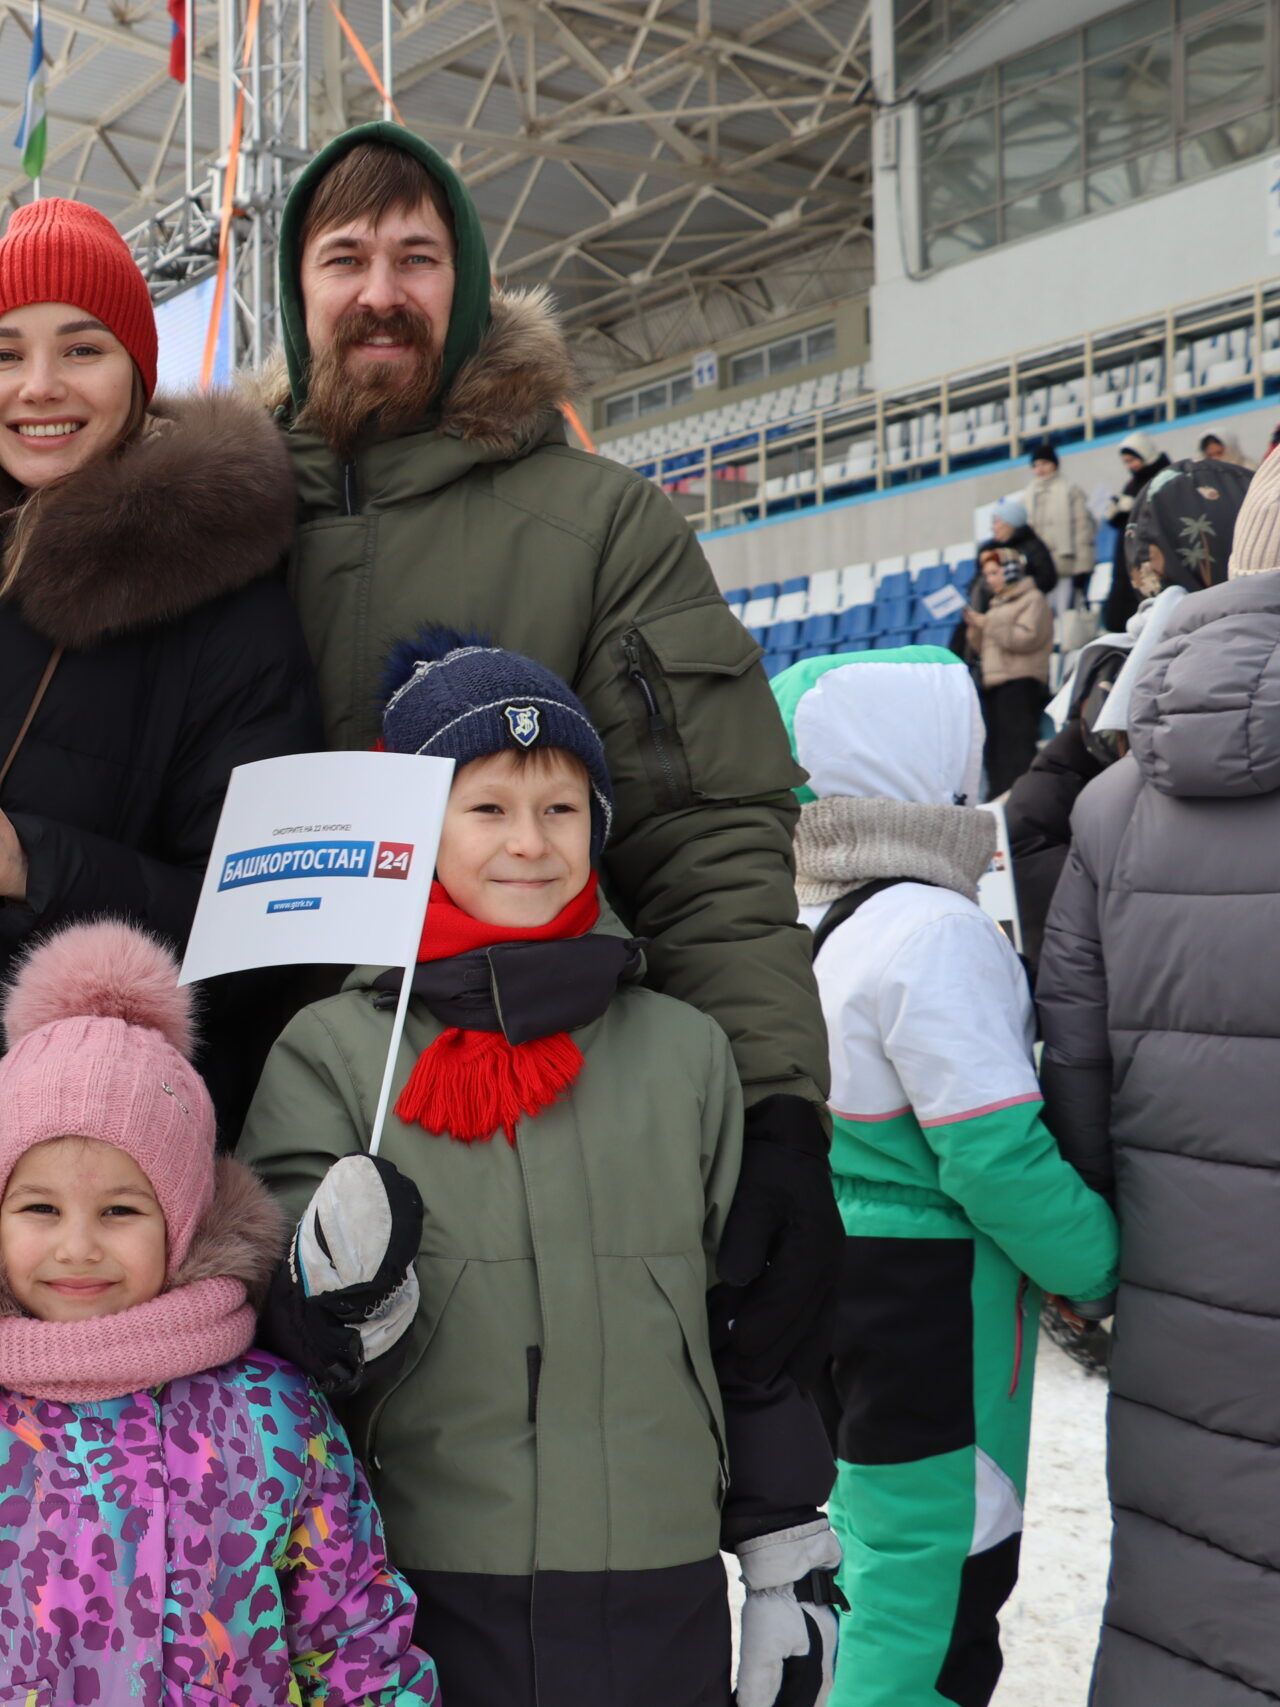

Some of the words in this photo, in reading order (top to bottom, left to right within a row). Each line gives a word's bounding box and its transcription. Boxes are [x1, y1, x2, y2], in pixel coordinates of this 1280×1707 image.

[272, 825, 303, 836] СМОТРИТЕ
[304, 825, 313, 833] НА
[222, 848, 367, 883] БАШКОРТОСТАН
[377, 850, 410, 871] 24
[272, 899, 314, 910] www.gtrk.tv
